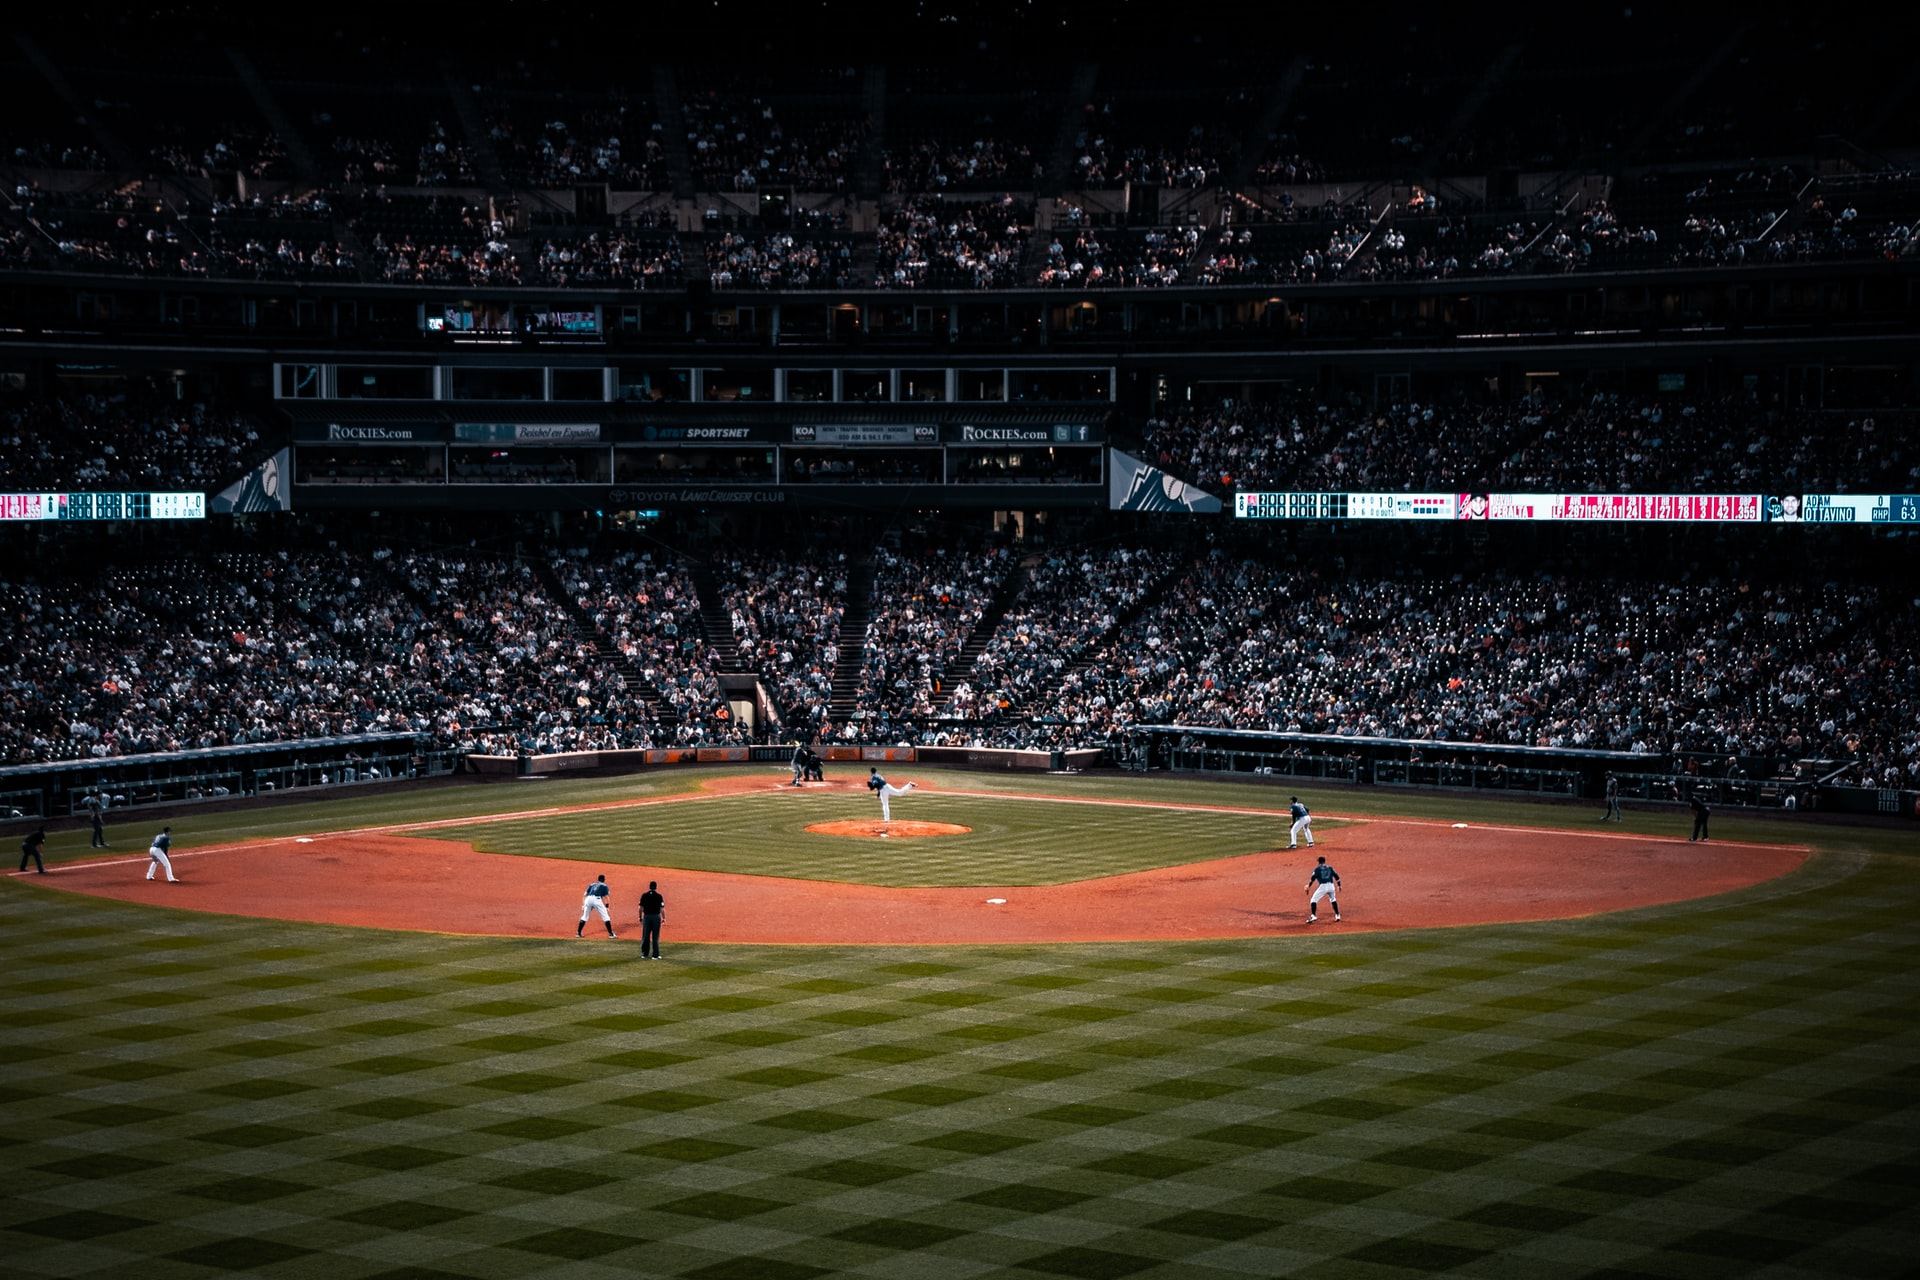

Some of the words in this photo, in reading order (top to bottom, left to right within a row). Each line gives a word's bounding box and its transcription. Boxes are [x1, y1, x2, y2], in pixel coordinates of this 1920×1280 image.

[686, 428, 750, 438] SPORTSNET
[795, 426, 815, 435] KOA
[915, 427, 935, 435] KOA
[630, 491, 677, 502] TOYOTA
[753, 491, 785, 502] CLUB
[1806, 496, 1830, 506] ADAM
[1492, 505, 1528, 518] PERALTA
[1565, 505, 1585, 518] .297
[1588, 505, 1622, 518] 152/511
[1626, 505, 1637, 518] 24
[1659, 505, 1671, 518] 27
[1678, 506, 1689, 518] 78
[1717, 506, 1729, 518] 42
[1735, 506, 1756, 518] .355
[1805, 507, 1853, 521] OTTAVINO
[1873, 509, 1889, 520] RHP
[1901, 506, 1916, 520] 6-3
